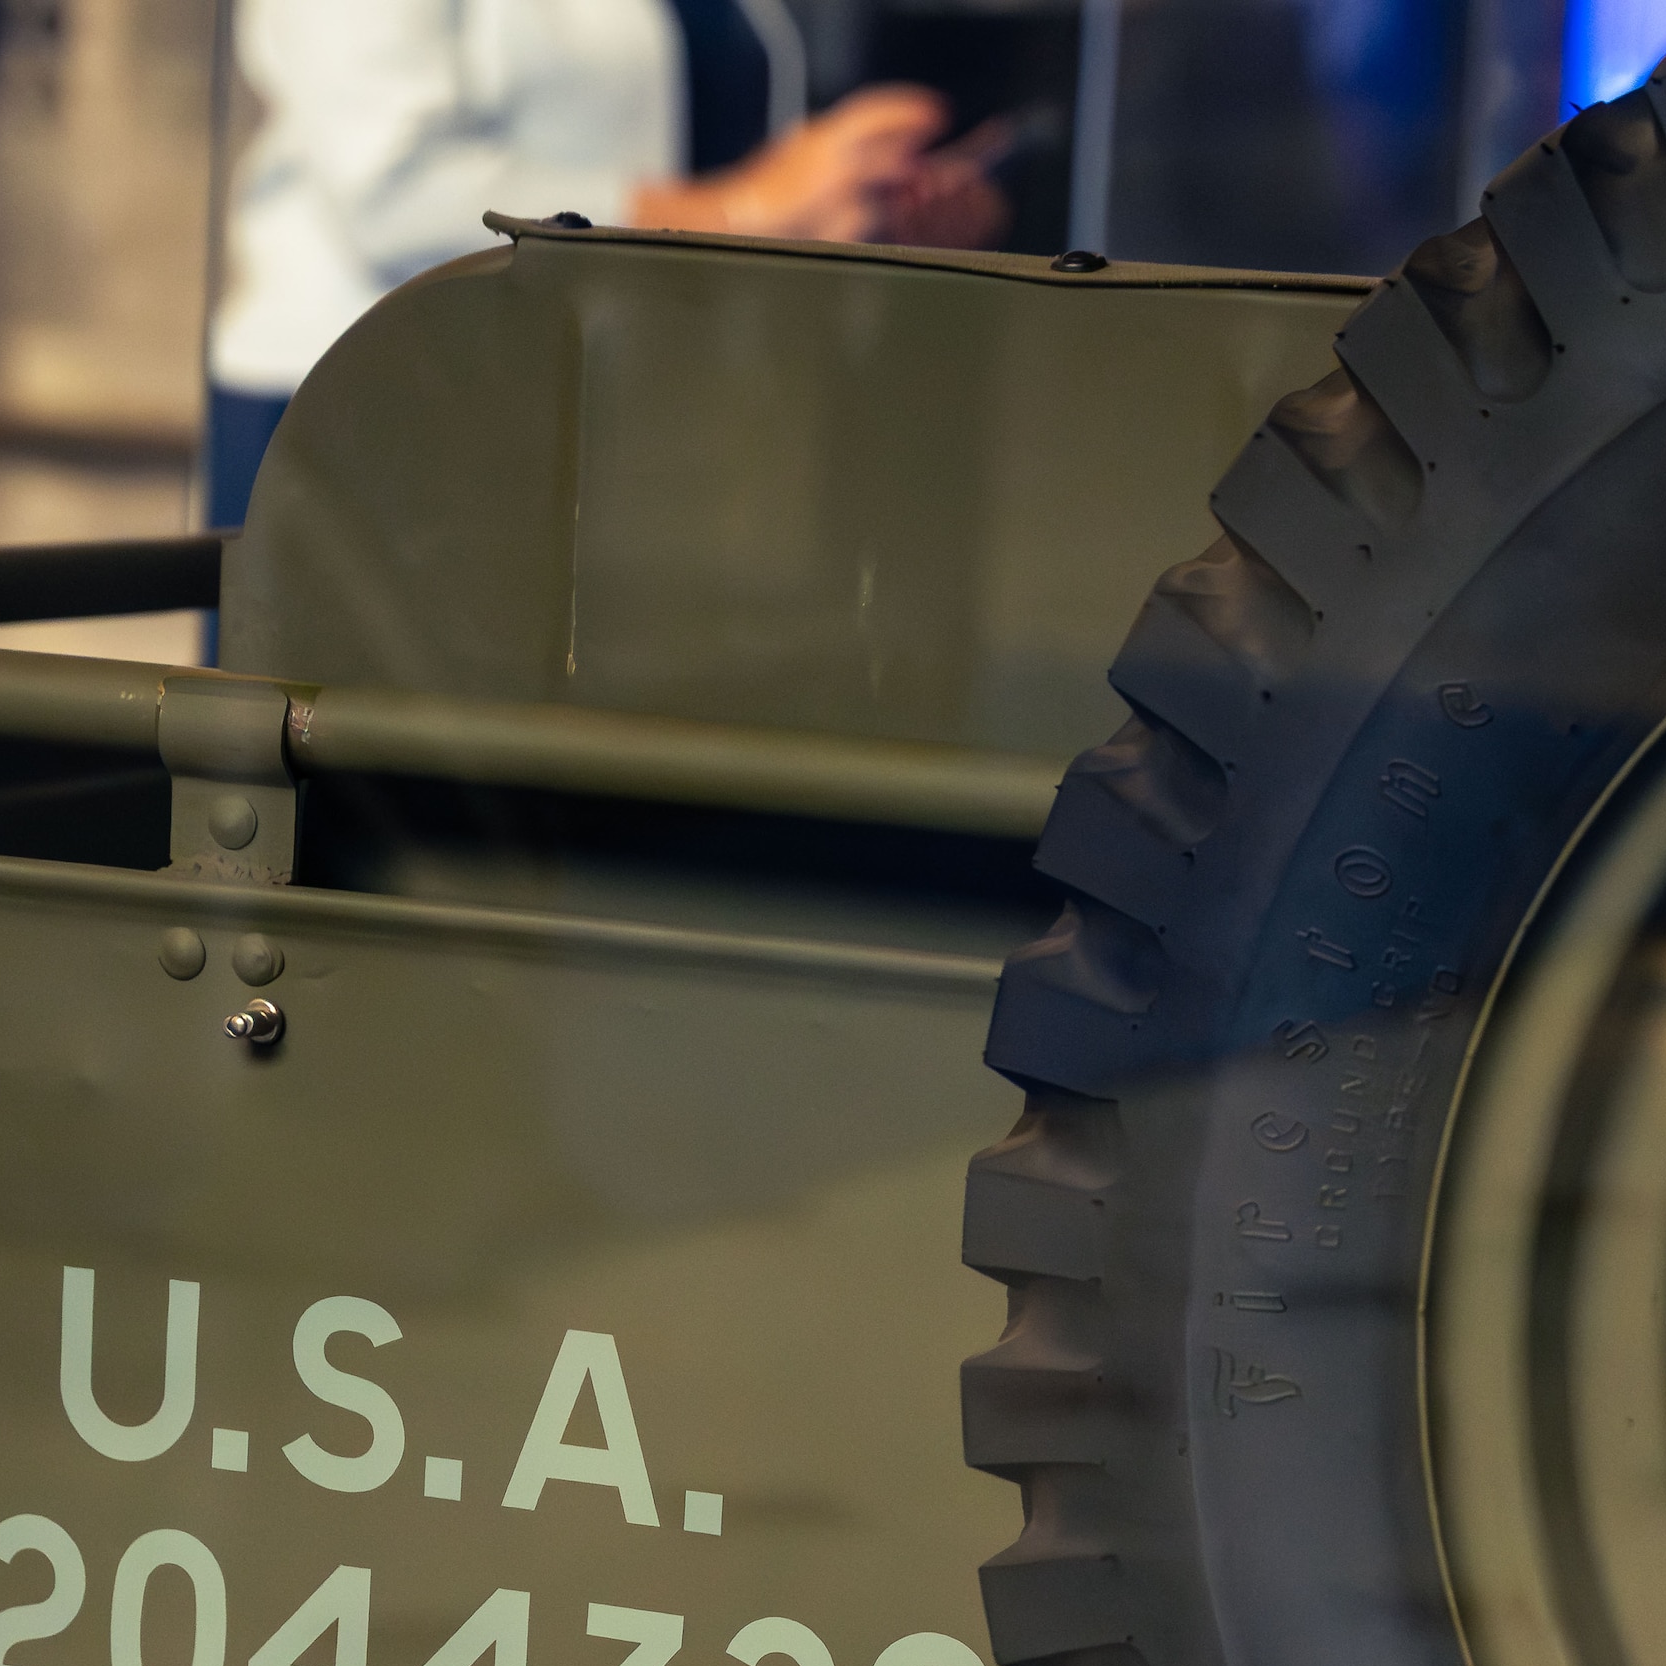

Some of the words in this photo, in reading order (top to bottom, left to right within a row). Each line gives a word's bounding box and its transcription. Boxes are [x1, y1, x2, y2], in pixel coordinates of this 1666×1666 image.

[1211, 678, 1493, 1418] Firestone
[1314, 1033, 1376, 1248] GROUND
[60, 1266, 724, 1537] U.S.A.
